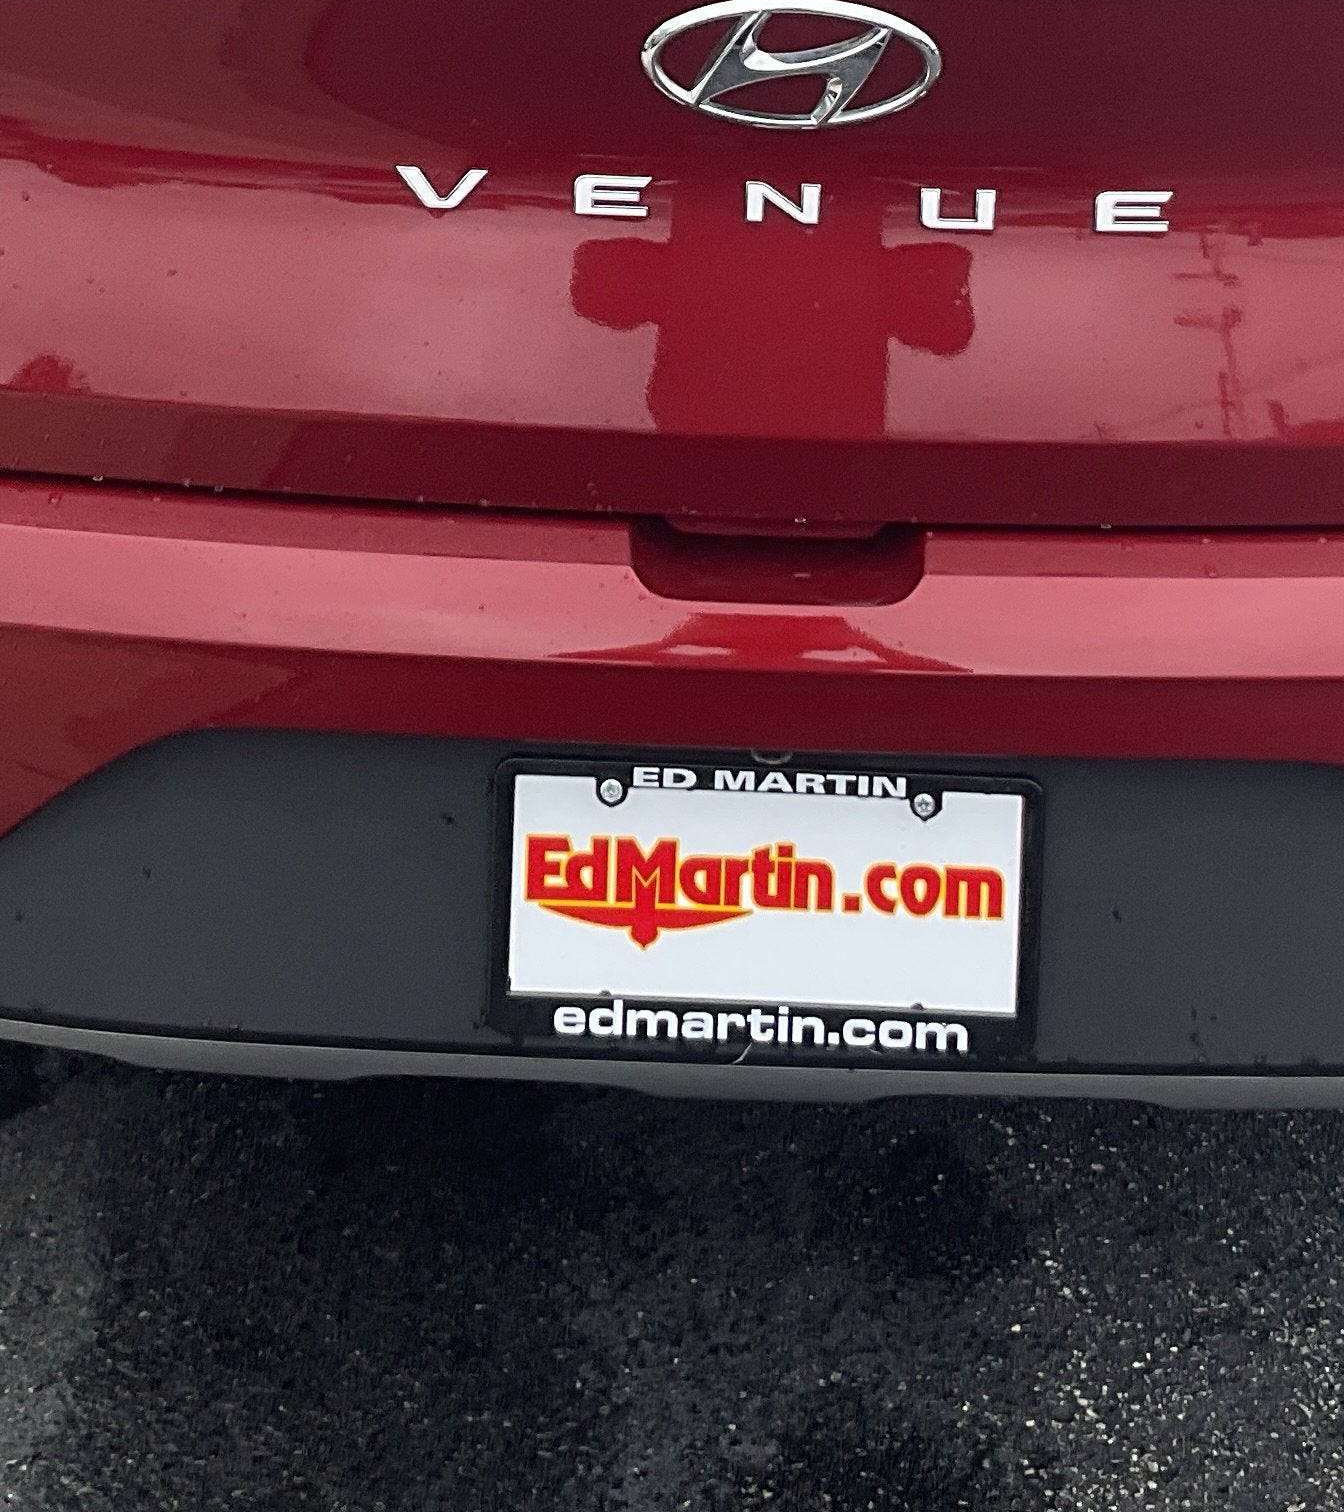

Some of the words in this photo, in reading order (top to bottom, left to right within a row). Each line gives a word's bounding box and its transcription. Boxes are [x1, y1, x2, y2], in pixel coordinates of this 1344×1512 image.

[394, 164, 1175, 233] VENUE
[631, 766, 698, 789] ED
[713, 769, 908, 799] MARTIN
[523, 833, 1006, 922] EdMartin.com
[553, 998, 969, 1053] edmartin.com
